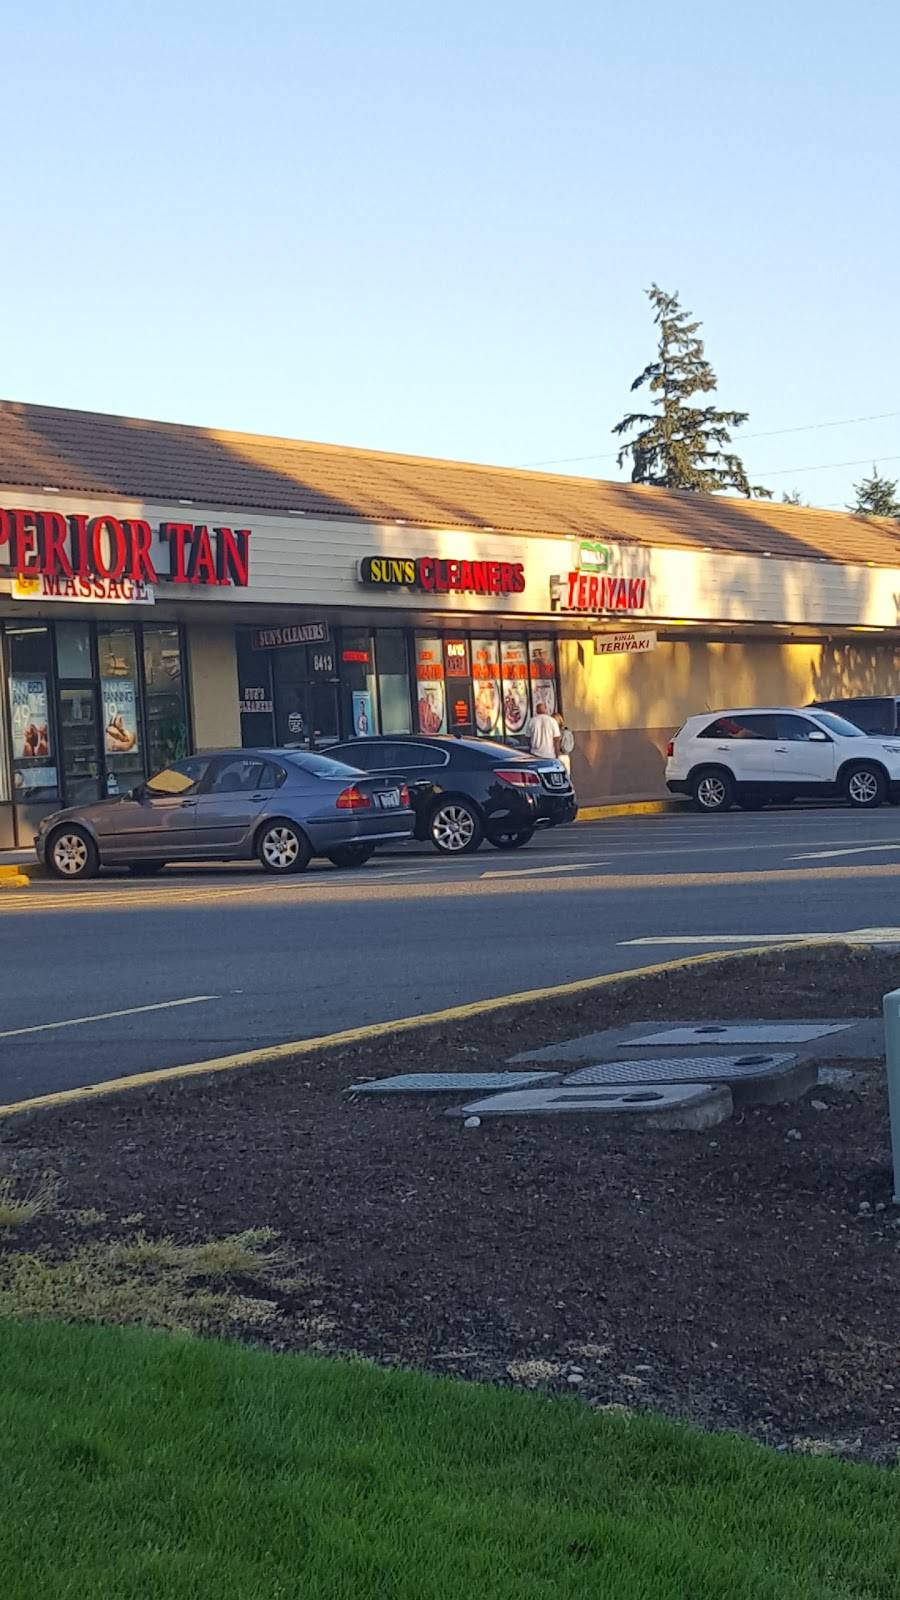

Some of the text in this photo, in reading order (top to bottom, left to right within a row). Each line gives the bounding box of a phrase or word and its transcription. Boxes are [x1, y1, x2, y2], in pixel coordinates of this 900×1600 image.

[160, 521, 251, 587] TAN
[43, 574, 149, 600] MASSAGE
[370, 557, 526, 593] SUN'S CLEANERS
[568, 572, 647, 609] TERIYAKI
[258, 623, 325, 646] SUN'S CLEANERS
[600, 640, 650, 653] TERIYAKI
[313, 655, 333, 672] 8413
